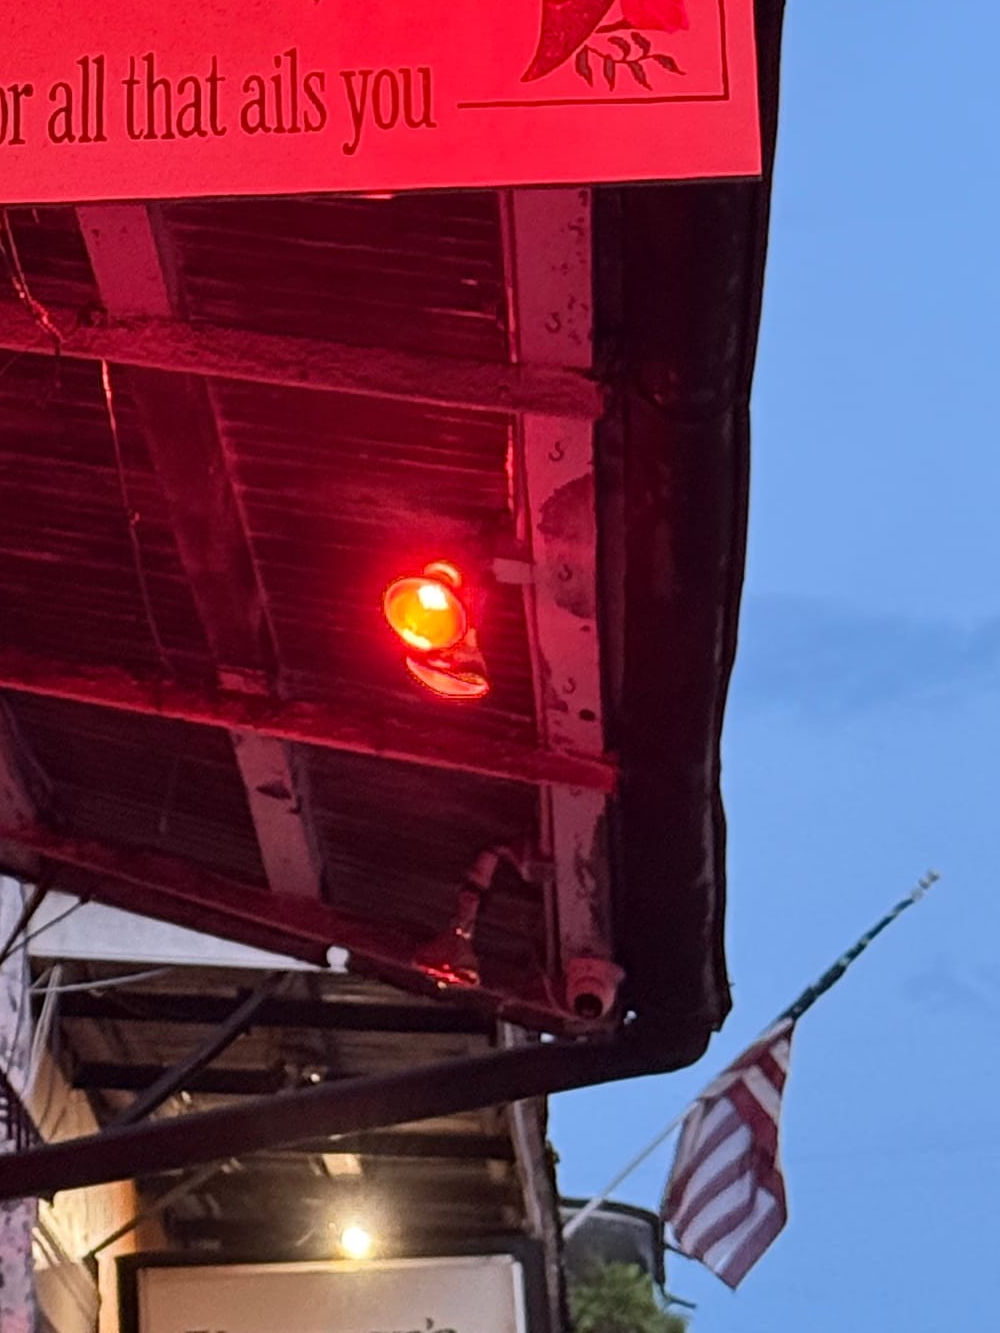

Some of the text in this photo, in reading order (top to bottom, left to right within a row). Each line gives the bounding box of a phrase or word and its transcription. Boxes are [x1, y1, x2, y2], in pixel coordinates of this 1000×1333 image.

[47, 53, 107, 145] all
[122, 51, 227, 141] that
[239, 46, 328, 135] ails
[339, 64, 438, 156] you
